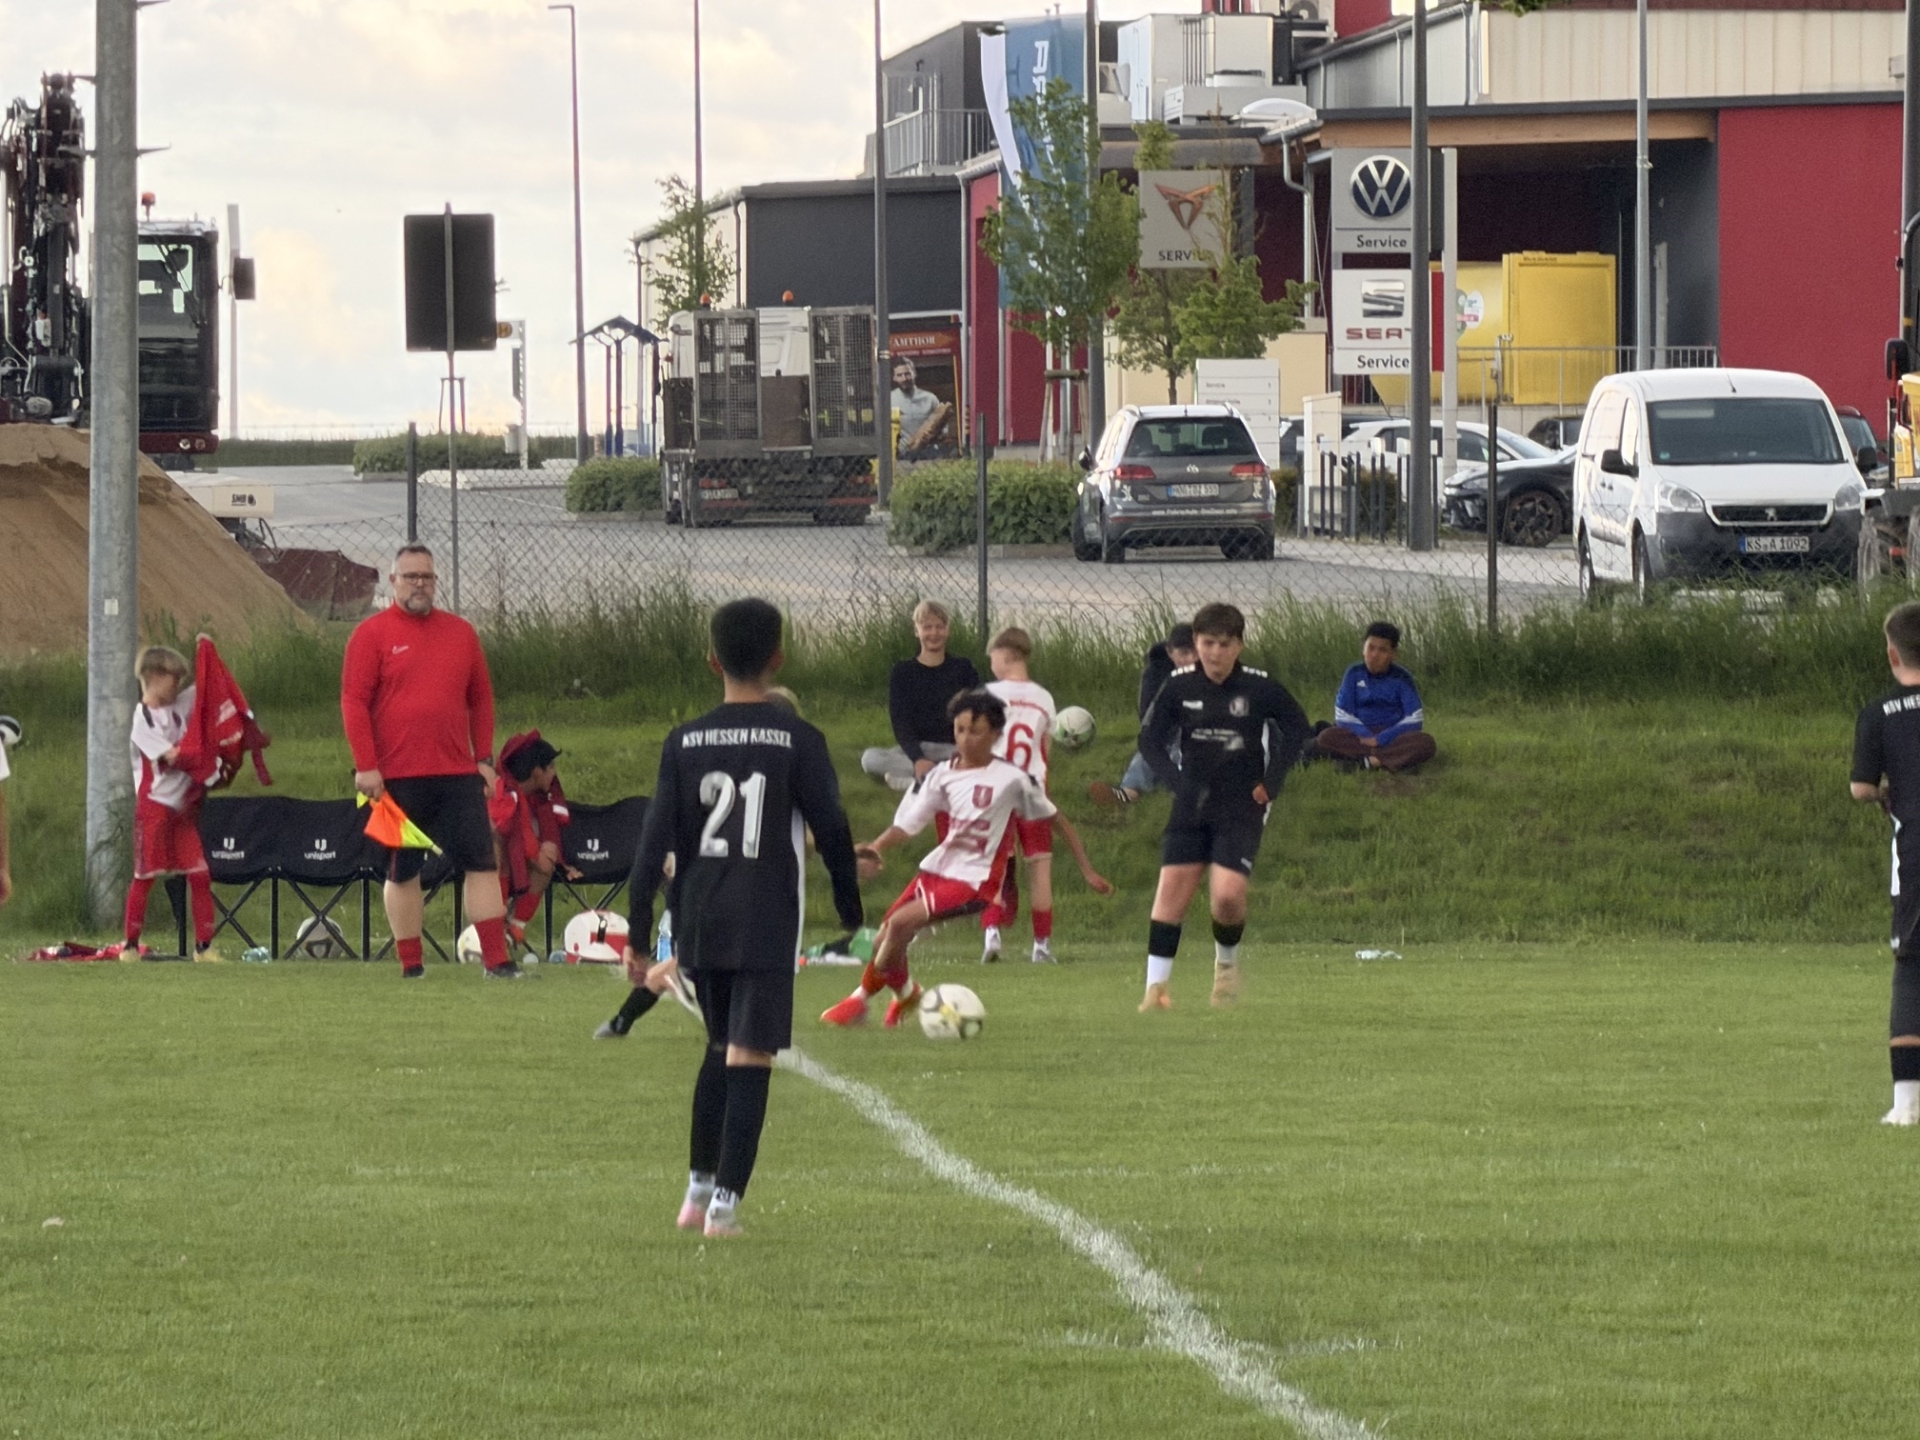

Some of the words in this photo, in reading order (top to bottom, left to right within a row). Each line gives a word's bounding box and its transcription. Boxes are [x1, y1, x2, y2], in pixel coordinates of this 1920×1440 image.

[1356, 234, 1407, 248] Service
[1158, 249, 1211, 261] SERV
[1357, 355, 1410, 369] Service
[705, 728, 749, 746] HESSEN
[750, 728, 792, 748] KASSEL
[1005, 722, 1034, 774] 6
[700, 771, 767, 859] 21
